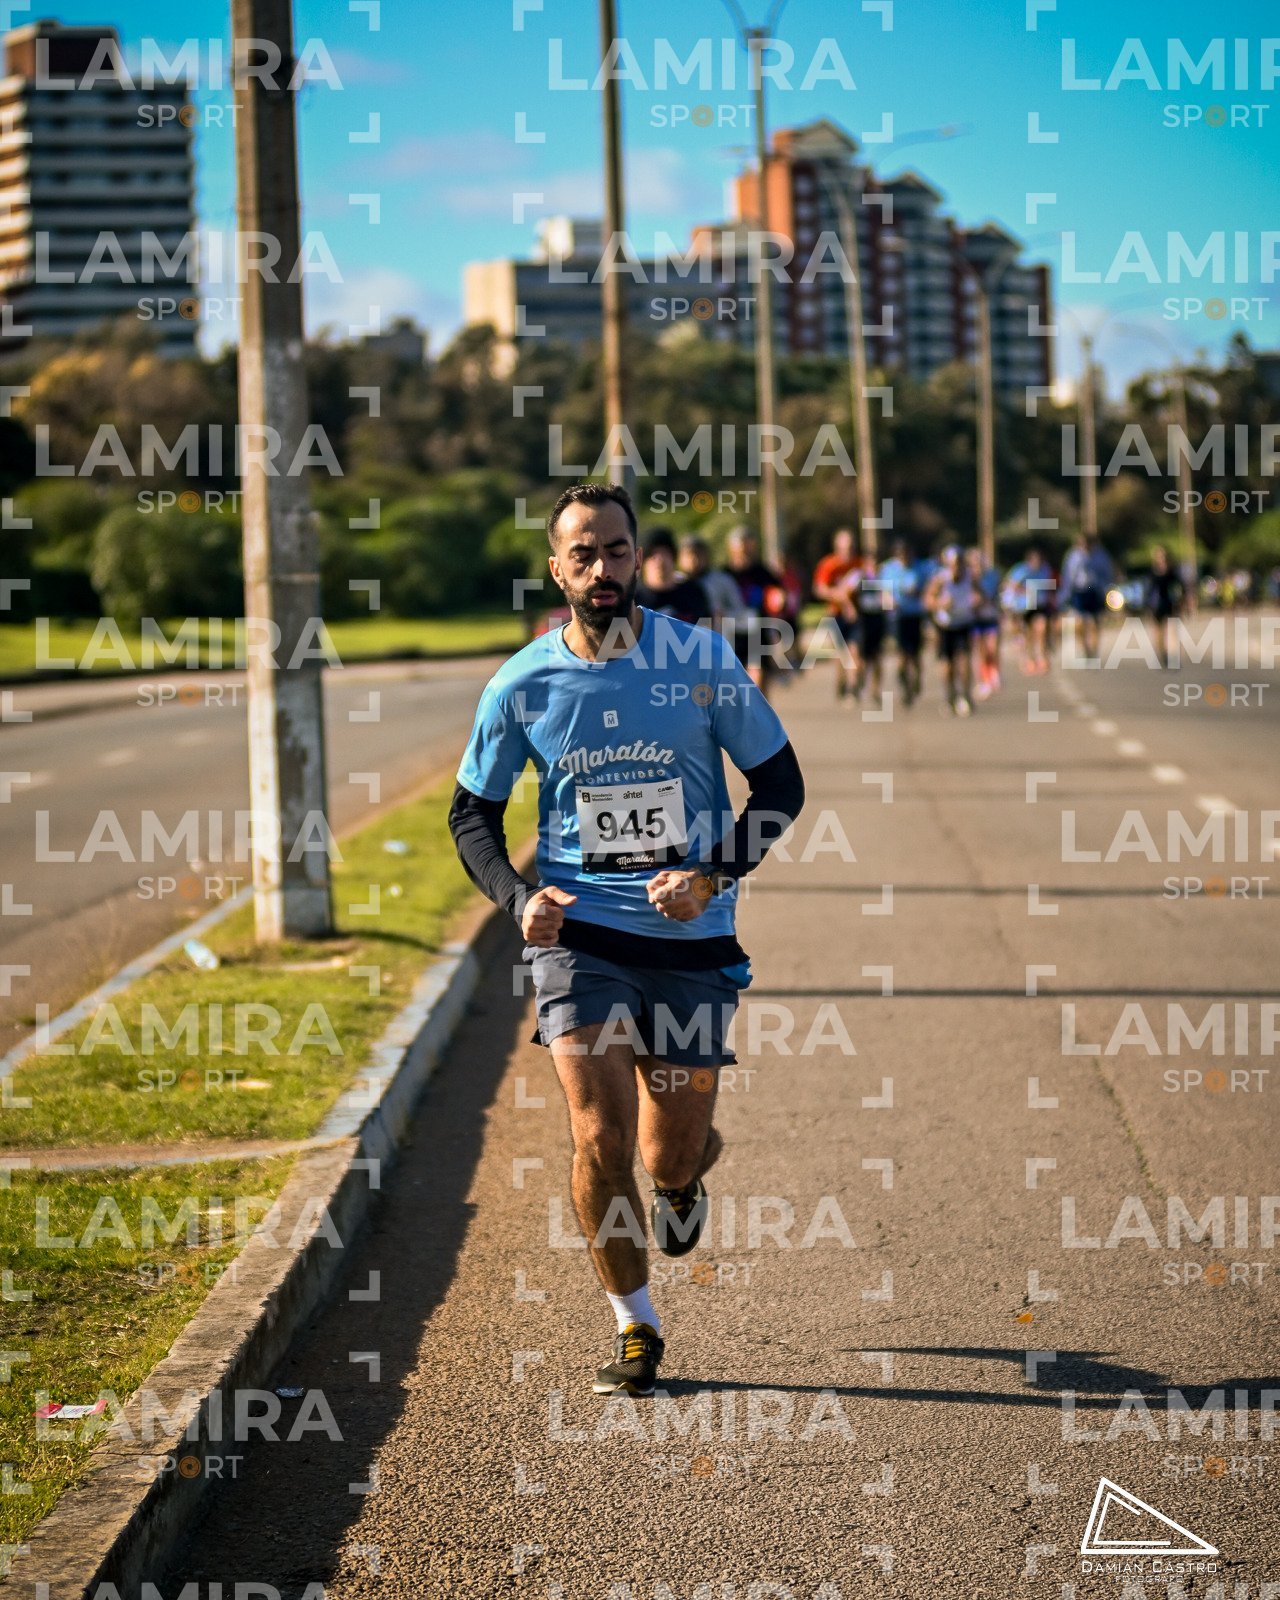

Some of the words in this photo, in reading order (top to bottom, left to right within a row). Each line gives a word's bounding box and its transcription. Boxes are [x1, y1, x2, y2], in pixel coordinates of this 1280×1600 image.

[558, 740, 676, 774] Maratón
[575, 769, 666, 785] MONTEVIDEO
[596, 807, 666, 842] 945
[616, 854, 655, 866] Maratón
